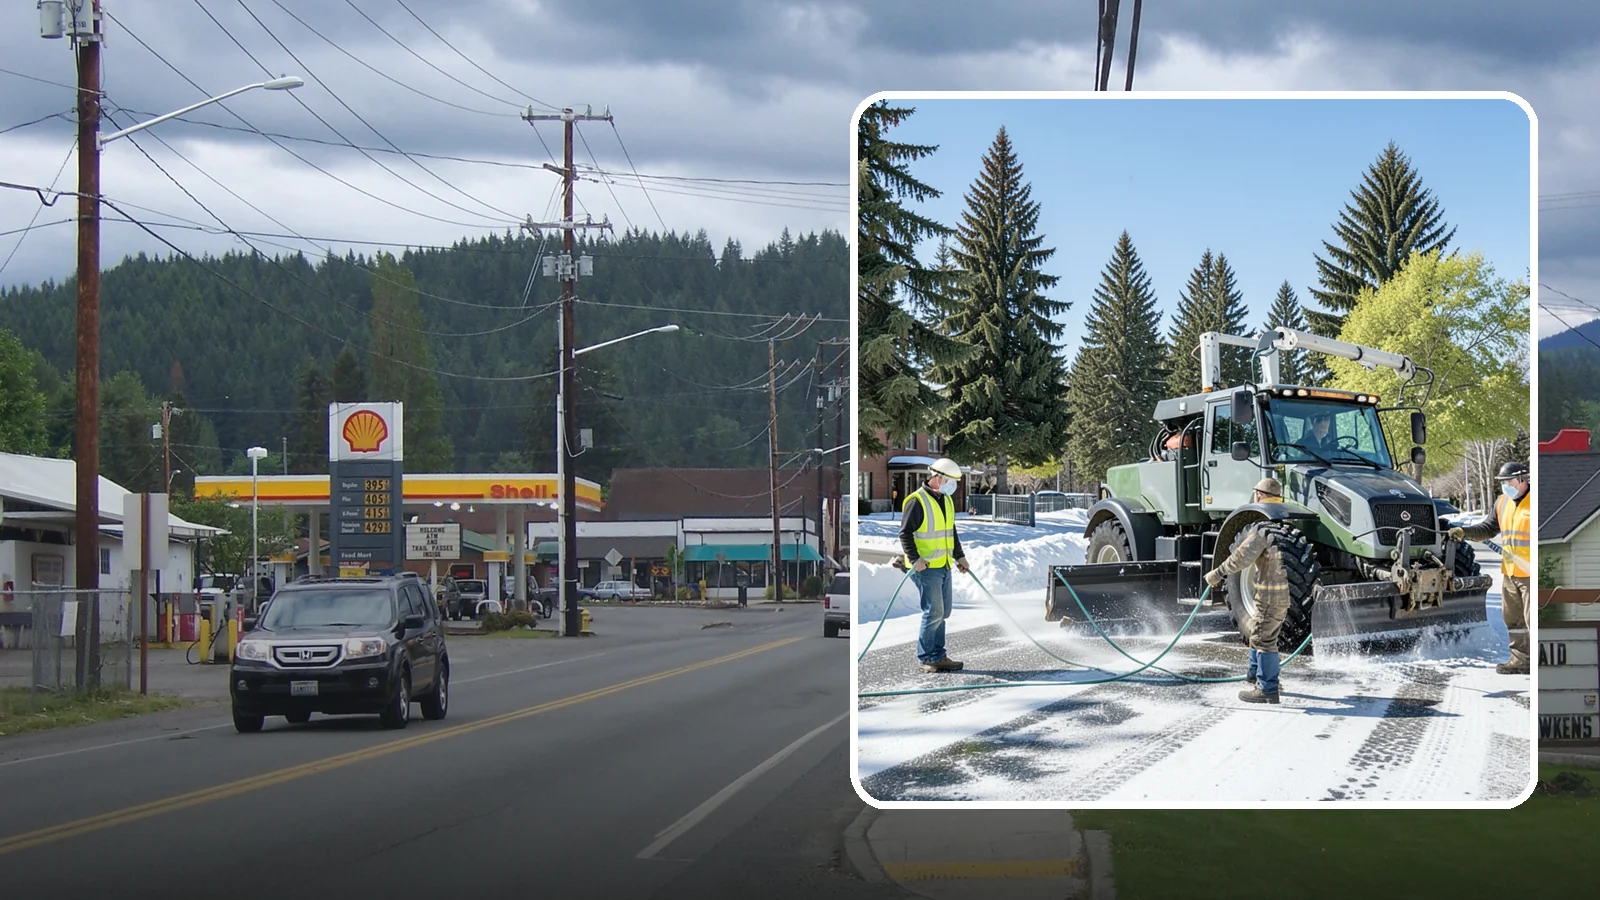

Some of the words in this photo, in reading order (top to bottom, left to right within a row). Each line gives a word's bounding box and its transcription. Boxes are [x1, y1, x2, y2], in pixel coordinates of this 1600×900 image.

[366, 480, 383, 490] 395
[490, 484, 547, 499] Shell
[365, 494, 383, 504] 405
[365, 508, 383, 518] 415
[365, 522, 383, 532] 429
[1539, 643, 1567, 665] AID
